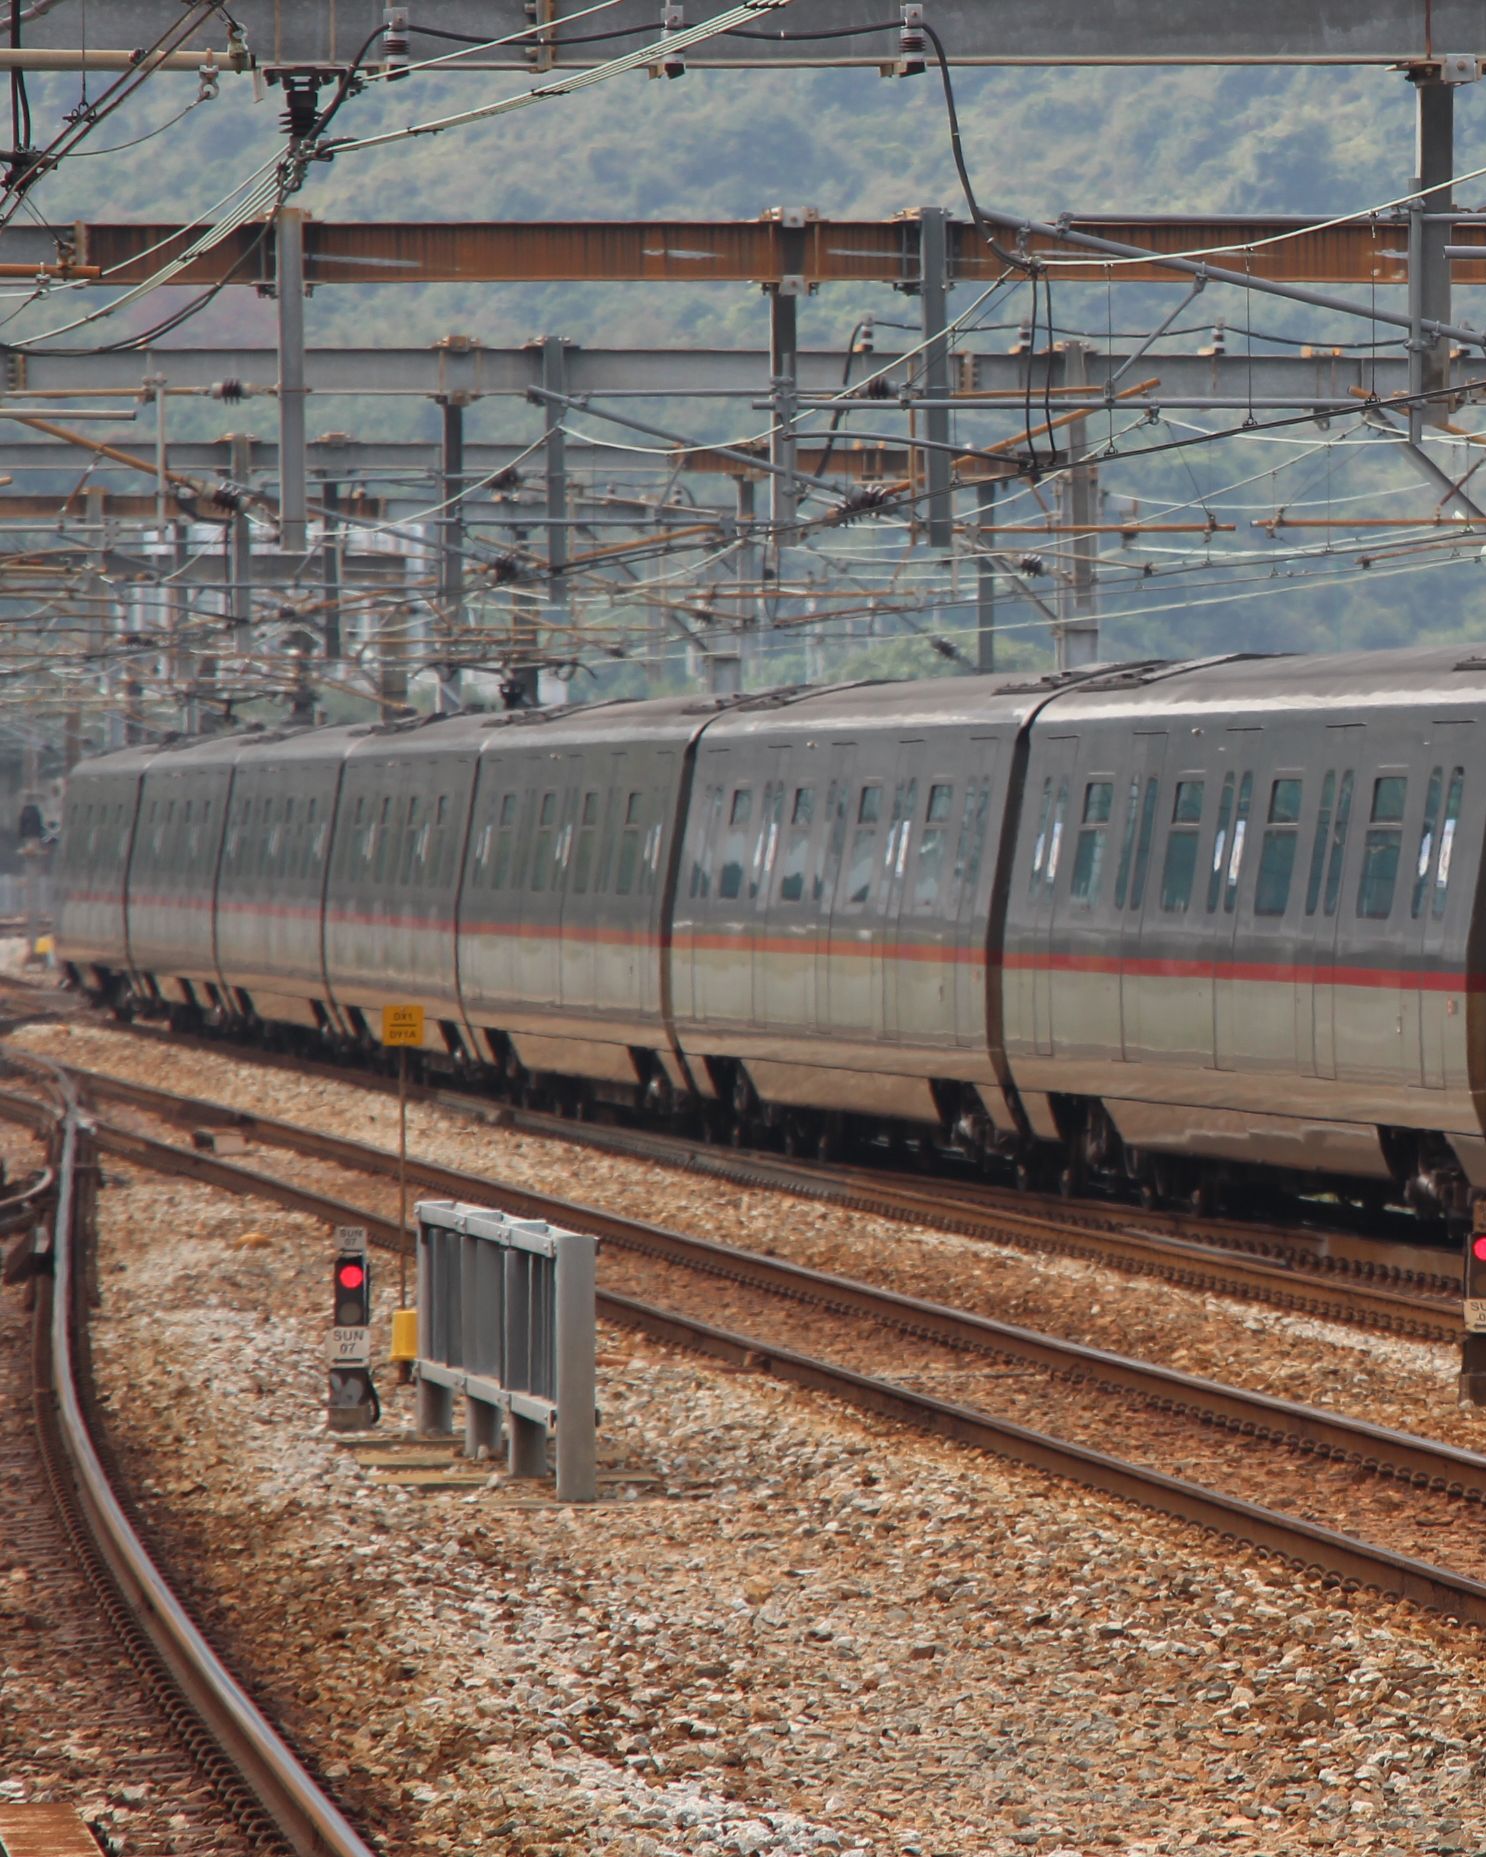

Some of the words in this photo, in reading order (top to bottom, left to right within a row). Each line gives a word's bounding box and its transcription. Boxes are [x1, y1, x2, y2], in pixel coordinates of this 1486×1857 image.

[339, 1229, 363, 1238] SUN
[333, 1330, 364, 1342] SUN
[339, 1343, 356, 1354] 07
